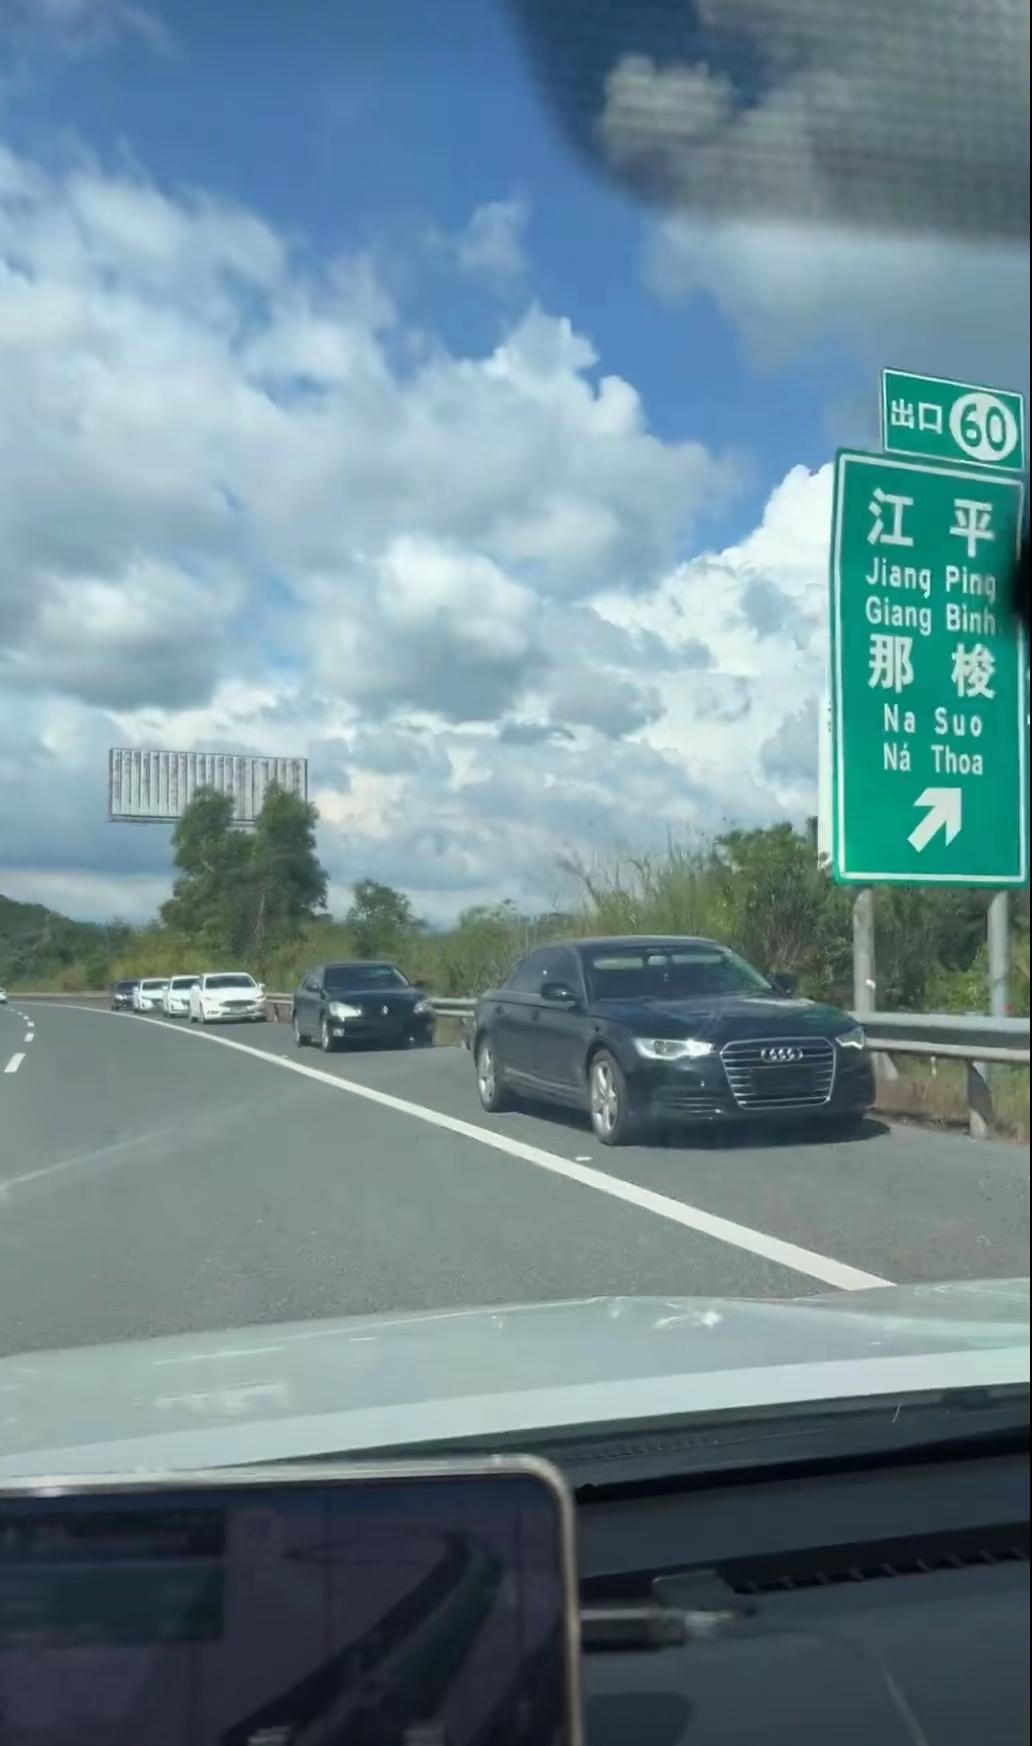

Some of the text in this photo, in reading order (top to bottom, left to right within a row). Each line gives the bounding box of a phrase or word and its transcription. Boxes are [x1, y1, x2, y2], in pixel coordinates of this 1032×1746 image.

[891, 398, 1007, 452] 出口 60
[865, 557, 996, 604] Jiang Ping
[865, 595, 996, 636] Giang Binh
[883, 703, 983, 737] Na Suo
[883, 742, 983, 775] Ná Thoa
